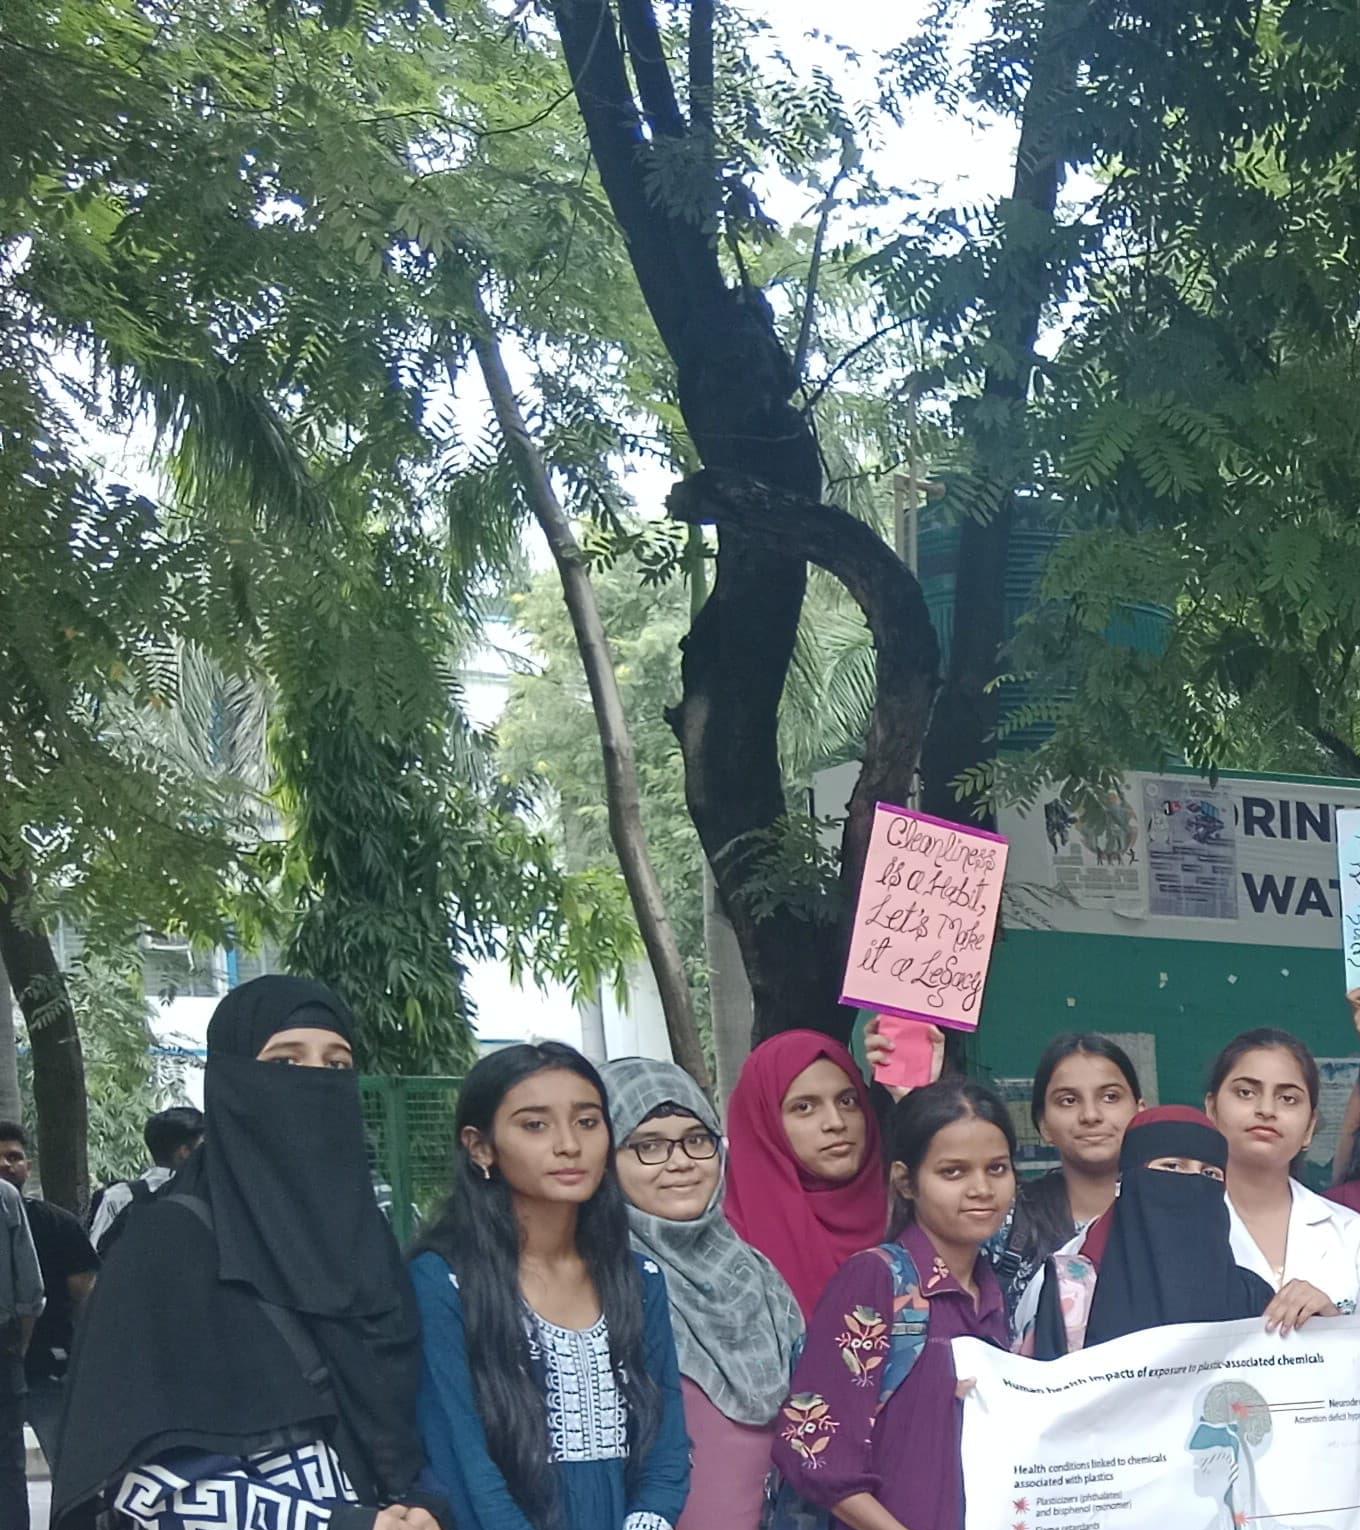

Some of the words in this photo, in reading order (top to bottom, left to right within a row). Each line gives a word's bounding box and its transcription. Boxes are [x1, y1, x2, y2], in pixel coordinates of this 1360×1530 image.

[887, 817, 996, 873] Cleanliness
[865, 895, 928, 941] Let's
[938, 913, 985, 952] Make
[911, 950, 981, 1011] Legacy
[1003, 1378, 1045, 1394] Human
[1046, 1378, 1087, 1393] health
[1089, 1370, 1134, 1382] impacts
[1137, 1366, 1147, 1378] of
[1149, 1365, 1187, 1378] exposure
[1188, 1363, 1196, 1373] to
[1277, 1353, 1325, 1365] chemicals
[1014, 1465, 1046, 1474] Health
[1048, 1461, 1090, 1472] conditions
[1091, 1458, 1116, 1468] linked
[1118, 1458, 1125, 1466] to
[1127, 1454, 1167, 1466] chemicals
[1014, 1475, 1063, 1488] associated
[1065, 1474, 1083, 1484] with
[1084, 1472, 1114, 1486] plastics
